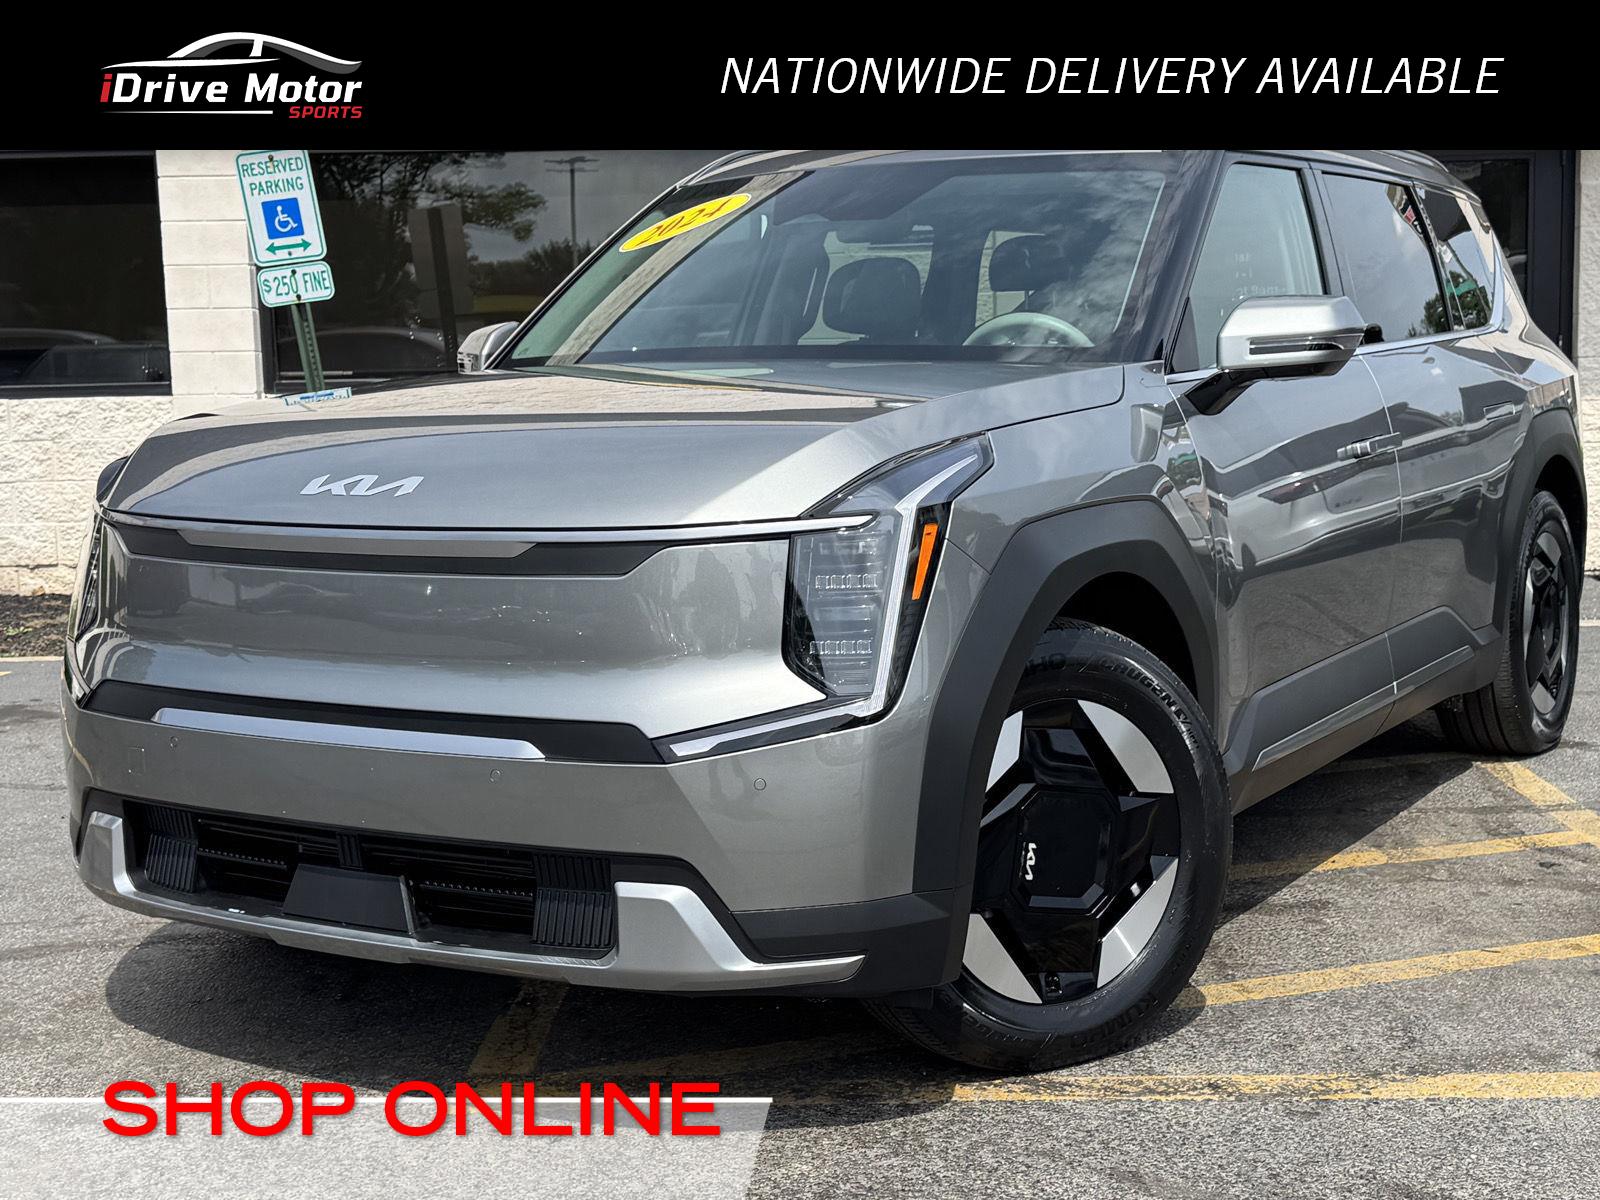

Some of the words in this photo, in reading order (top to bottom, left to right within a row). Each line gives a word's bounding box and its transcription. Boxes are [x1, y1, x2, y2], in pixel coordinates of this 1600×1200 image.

[241, 156, 304, 178] RESERVED
[249, 176, 304, 197] PARKING
[634, 199, 732, 247] 2024
[302, 270, 330, 293] FINE
[299, 473, 425, 497] KIA
